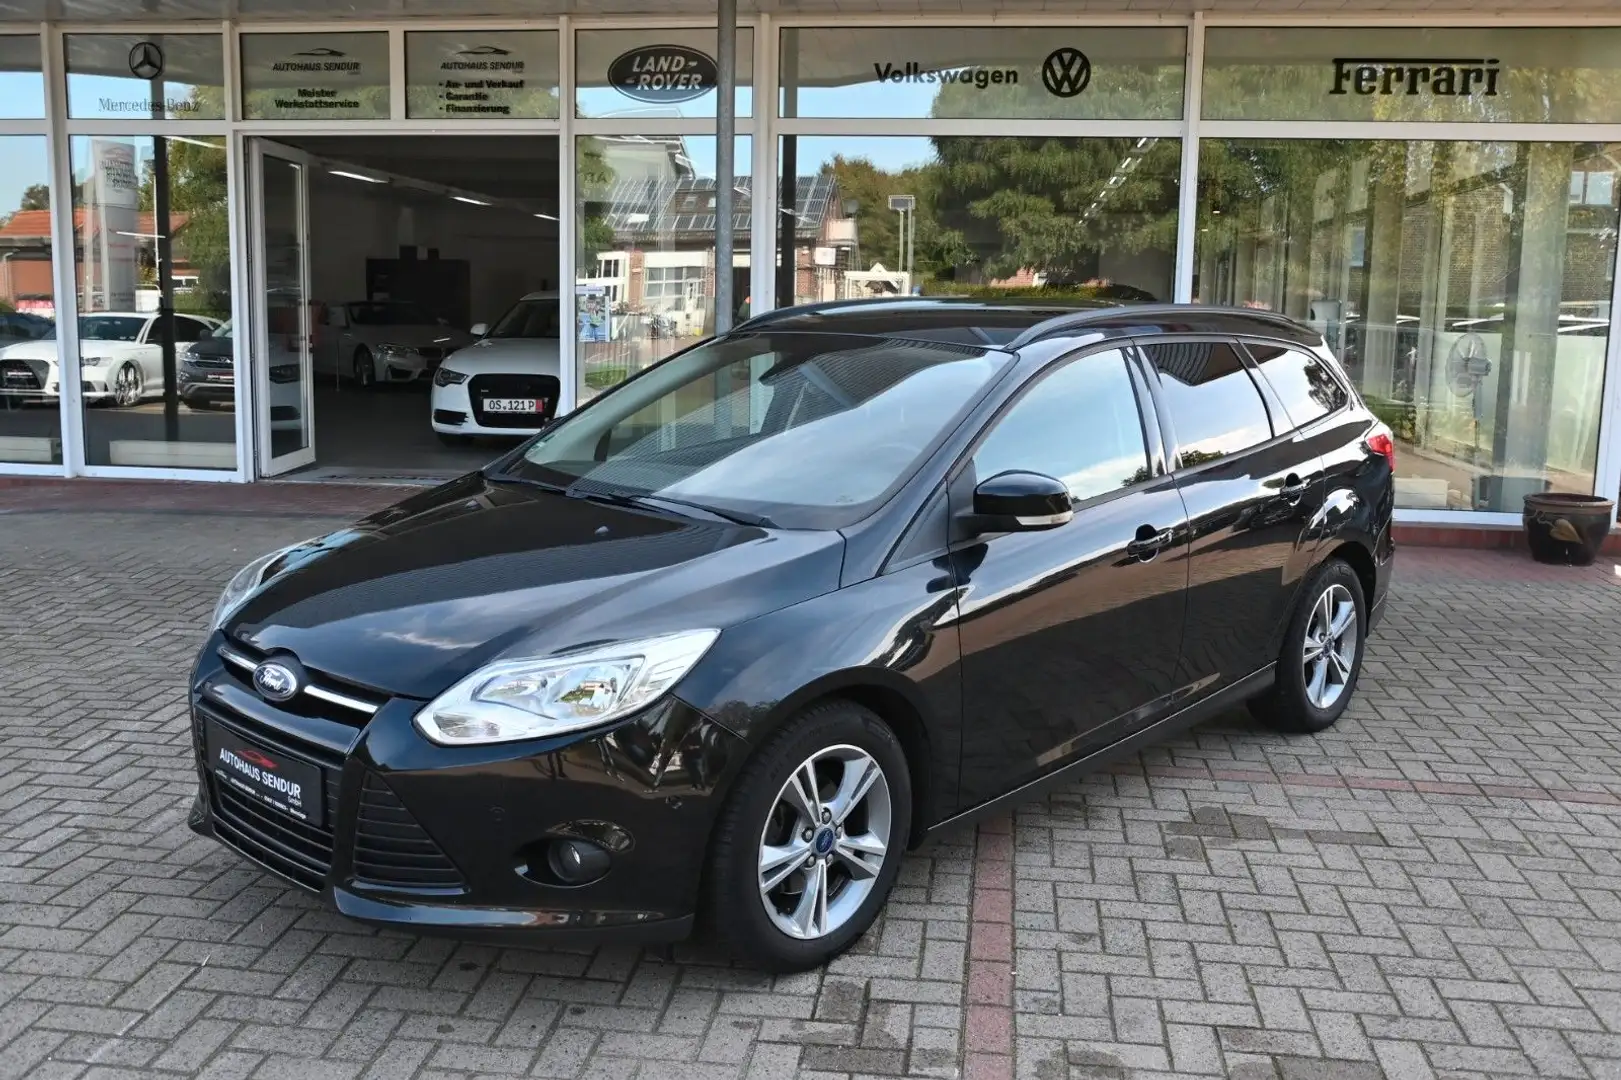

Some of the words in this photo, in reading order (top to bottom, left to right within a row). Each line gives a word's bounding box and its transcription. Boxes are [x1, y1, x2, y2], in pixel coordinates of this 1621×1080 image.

[272, 62, 321, 71] AUTOHAUS
[323, 62, 360, 71] SENDUR
[440, 62, 488, 70] AUTOHAUS
[489, 61, 525, 70] SENDUR
[873, 61, 1019, 90] Volkswagen
[1328, 57, 1500, 96] Ferrari
[464, 80, 484, 88] und
[485, 80, 525, 89] Verkauf
[298, 88, 337, 97] Meister
[445, 91, 489, 101] Garantie
[98, 97, 201, 112] Mercedes-Benz
[274, 99, 360, 109] Werkstattservice
[445, 104, 511, 115] Finanzierung
[260, 667, 285, 690] Ford
[219, 747, 261, 781] AUTOHAUS
[261, 771, 301, 799] SENDUR
